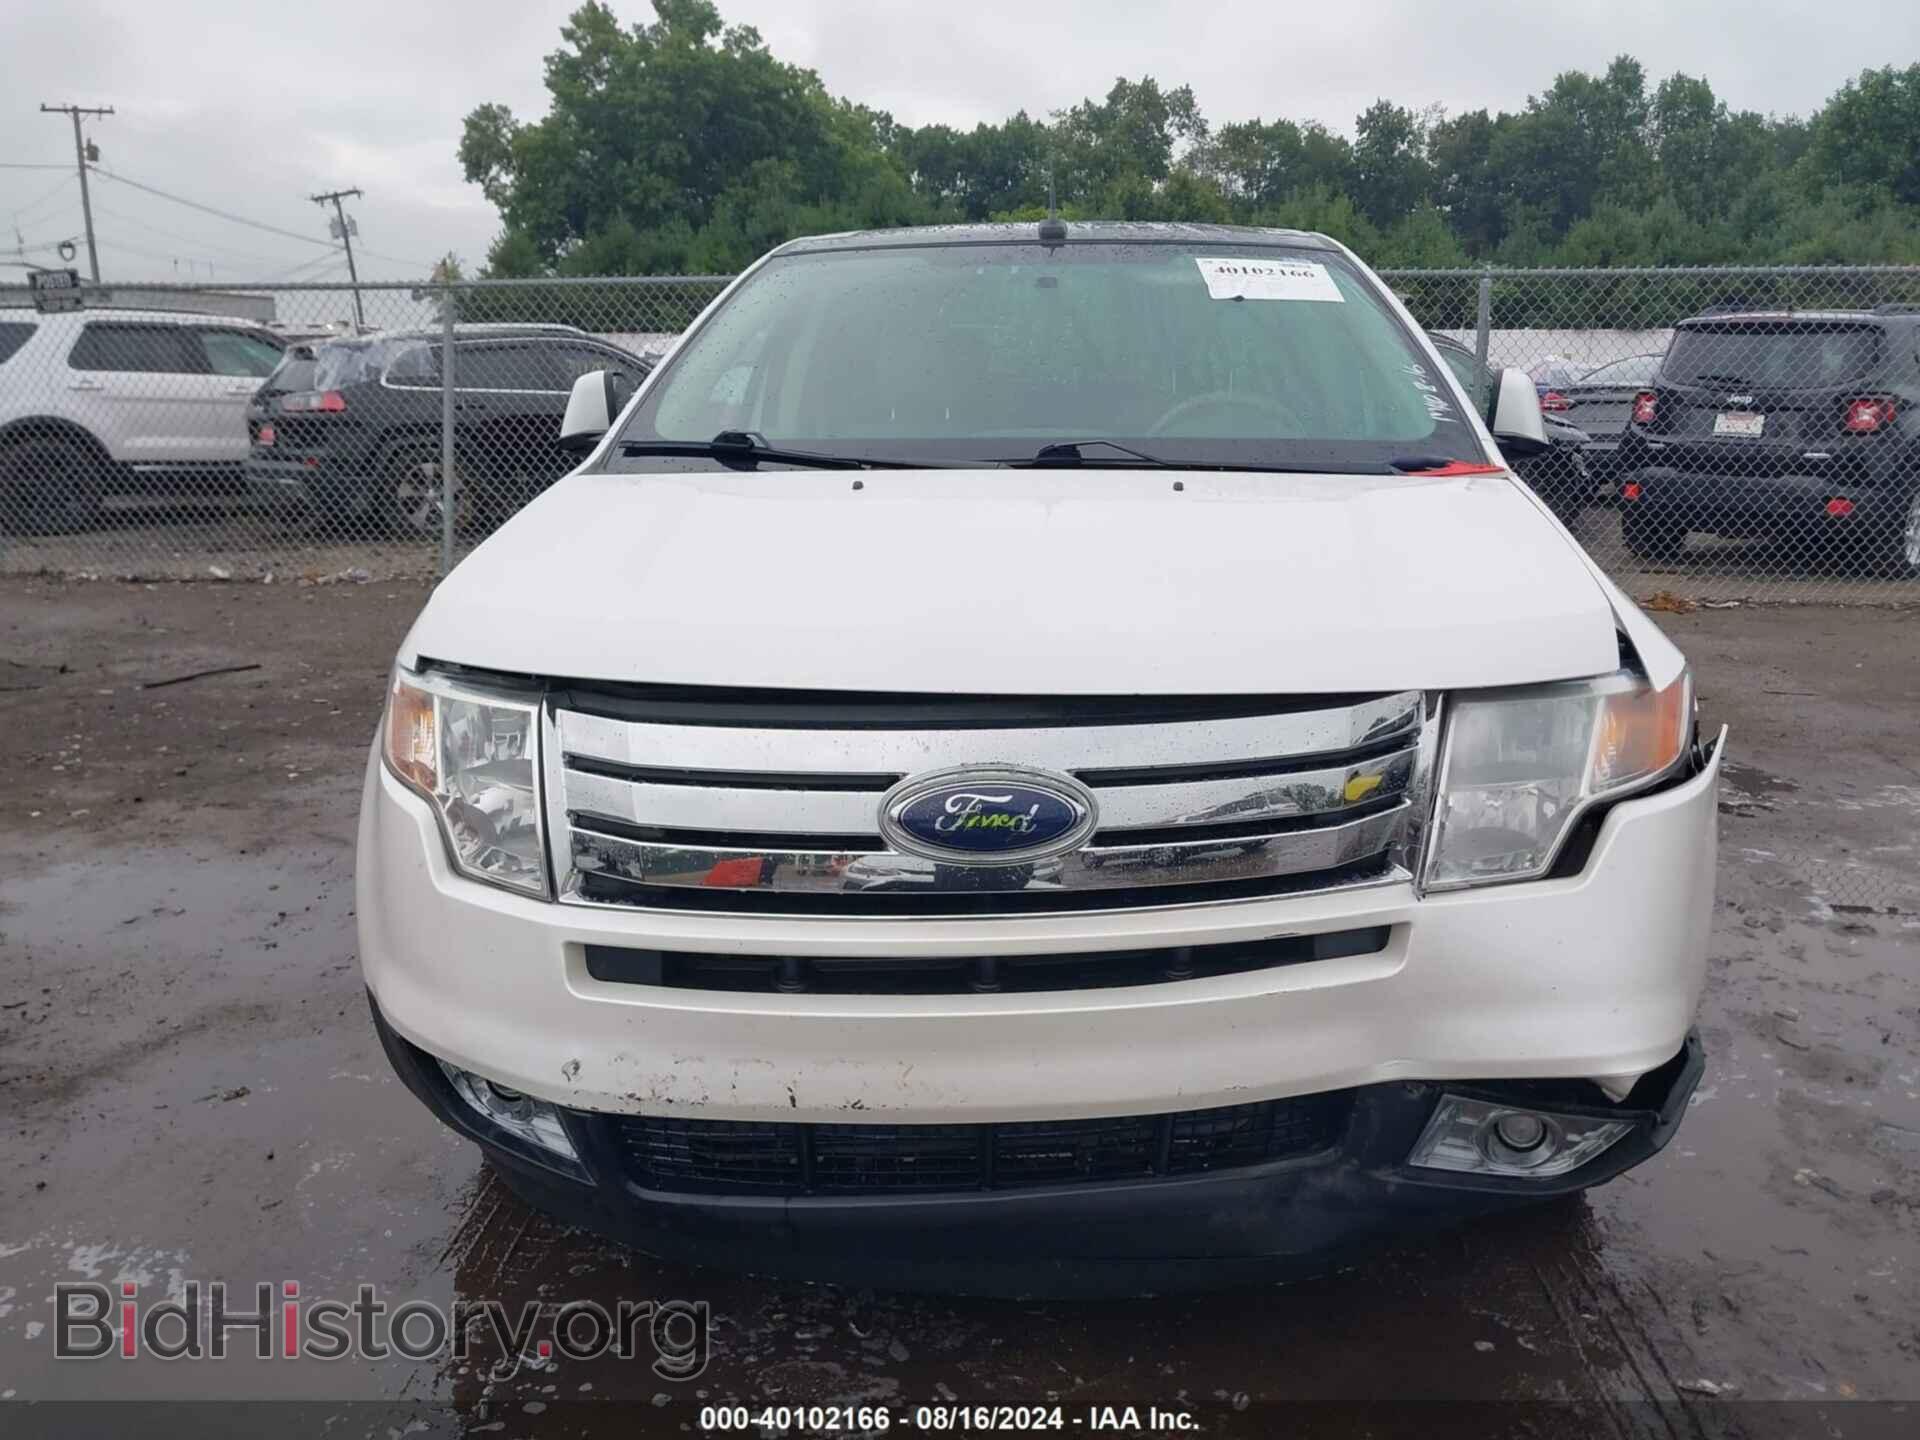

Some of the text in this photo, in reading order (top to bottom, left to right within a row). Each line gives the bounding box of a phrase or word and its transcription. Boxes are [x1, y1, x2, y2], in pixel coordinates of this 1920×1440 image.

[1214, 266, 1316, 279] 40102166
[1726, 393, 1753, 406] Jeep
[934, 793, 1040, 833] Ford
